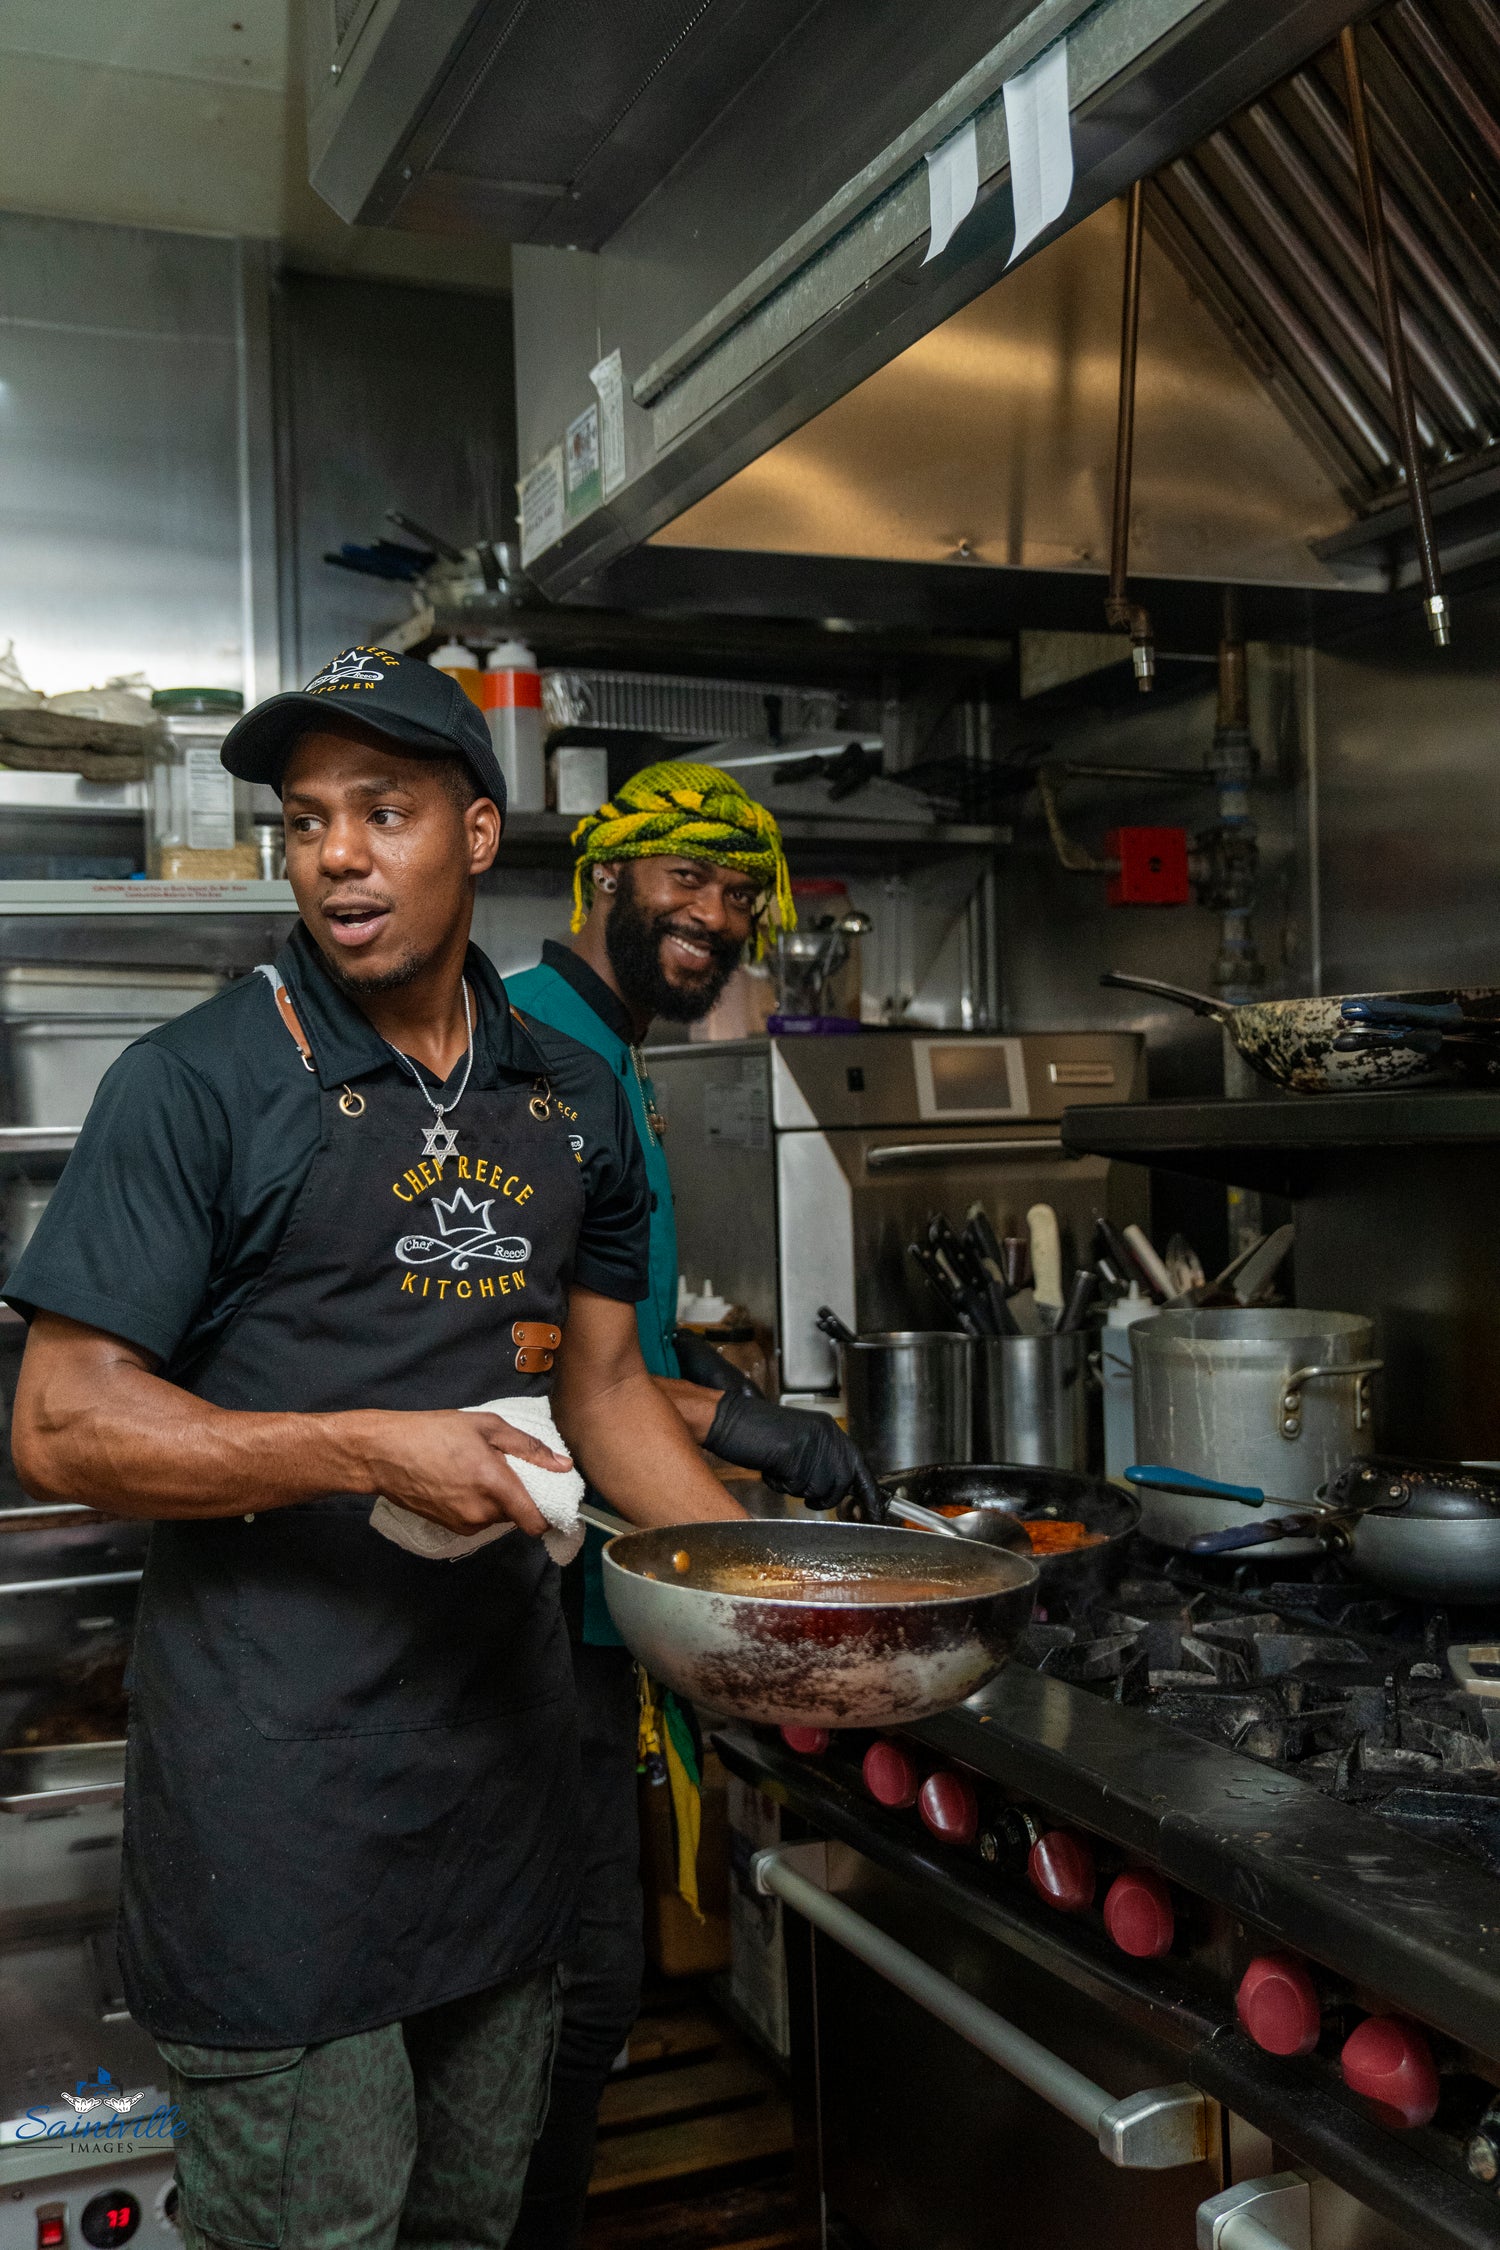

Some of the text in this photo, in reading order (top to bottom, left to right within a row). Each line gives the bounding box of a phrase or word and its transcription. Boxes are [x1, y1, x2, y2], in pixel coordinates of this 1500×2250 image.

[458, 1155, 534, 1206] REECE
[403, 1239, 526, 1259] Chef Reece
[401, 1269, 527, 1300] KITCHEN
